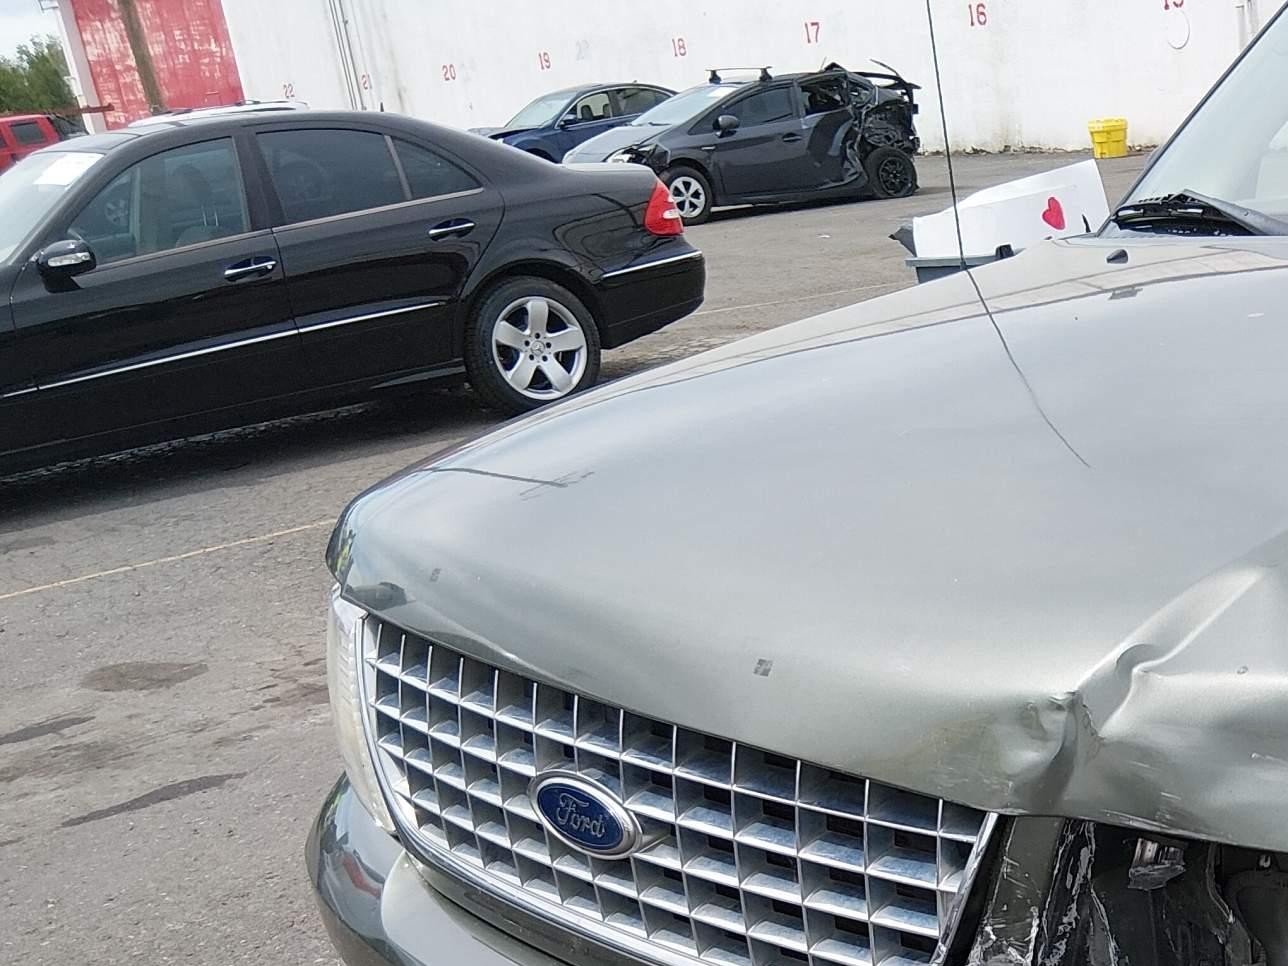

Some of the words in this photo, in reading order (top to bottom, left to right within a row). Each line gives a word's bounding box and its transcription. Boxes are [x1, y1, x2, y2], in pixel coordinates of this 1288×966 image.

[968, 3, 987, 27] 16
[804, 21, 823, 44] 17
[671, 38, 688, 58] 18
[538, 51, 552, 71] 19
[361, 74, 373, 90] 21
[442, 64, 457, 81] 20
[283, 83, 296, 99] 22
[556, 793, 606, 838] Ford
